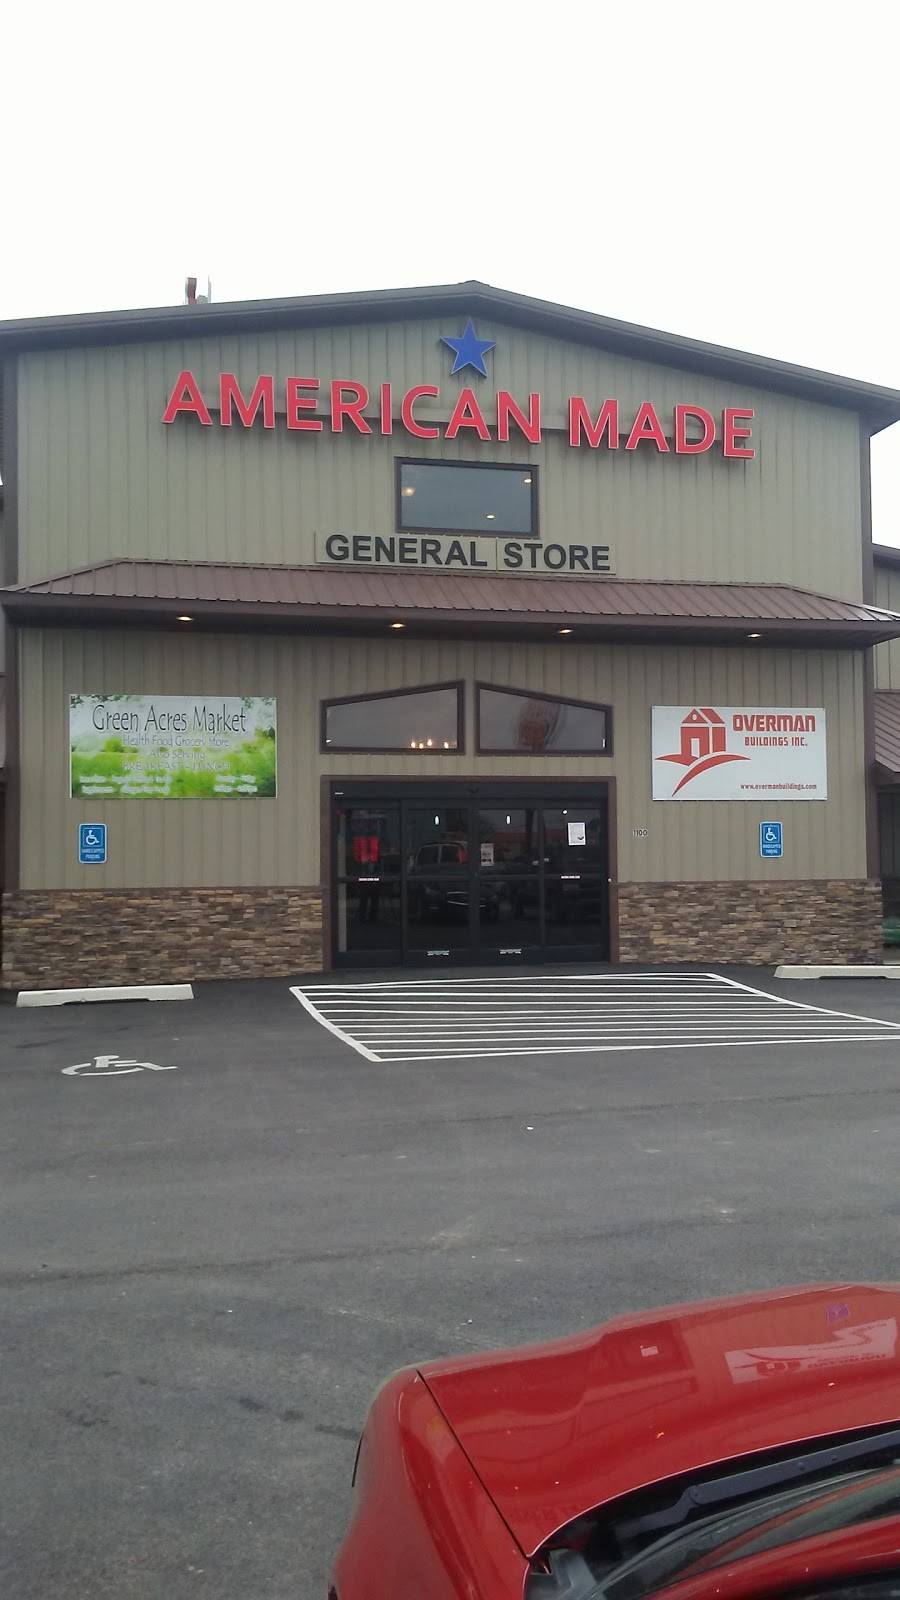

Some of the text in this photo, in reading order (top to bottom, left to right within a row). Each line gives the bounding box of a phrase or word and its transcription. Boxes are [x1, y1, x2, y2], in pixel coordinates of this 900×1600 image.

[162, 370, 757, 460] AMERICAN MADE
[325, 533, 611, 571] GENERAL STORE
[92, 703, 247, 734] Green Acres Market
[732, 714, 816, 732] OVERMAN
[744, 737, 808, 747] BUILDINGS INC.
[740, 783, 817, 791] www.overmanbuildings.com
[632, 829, 648, 838] 1100
